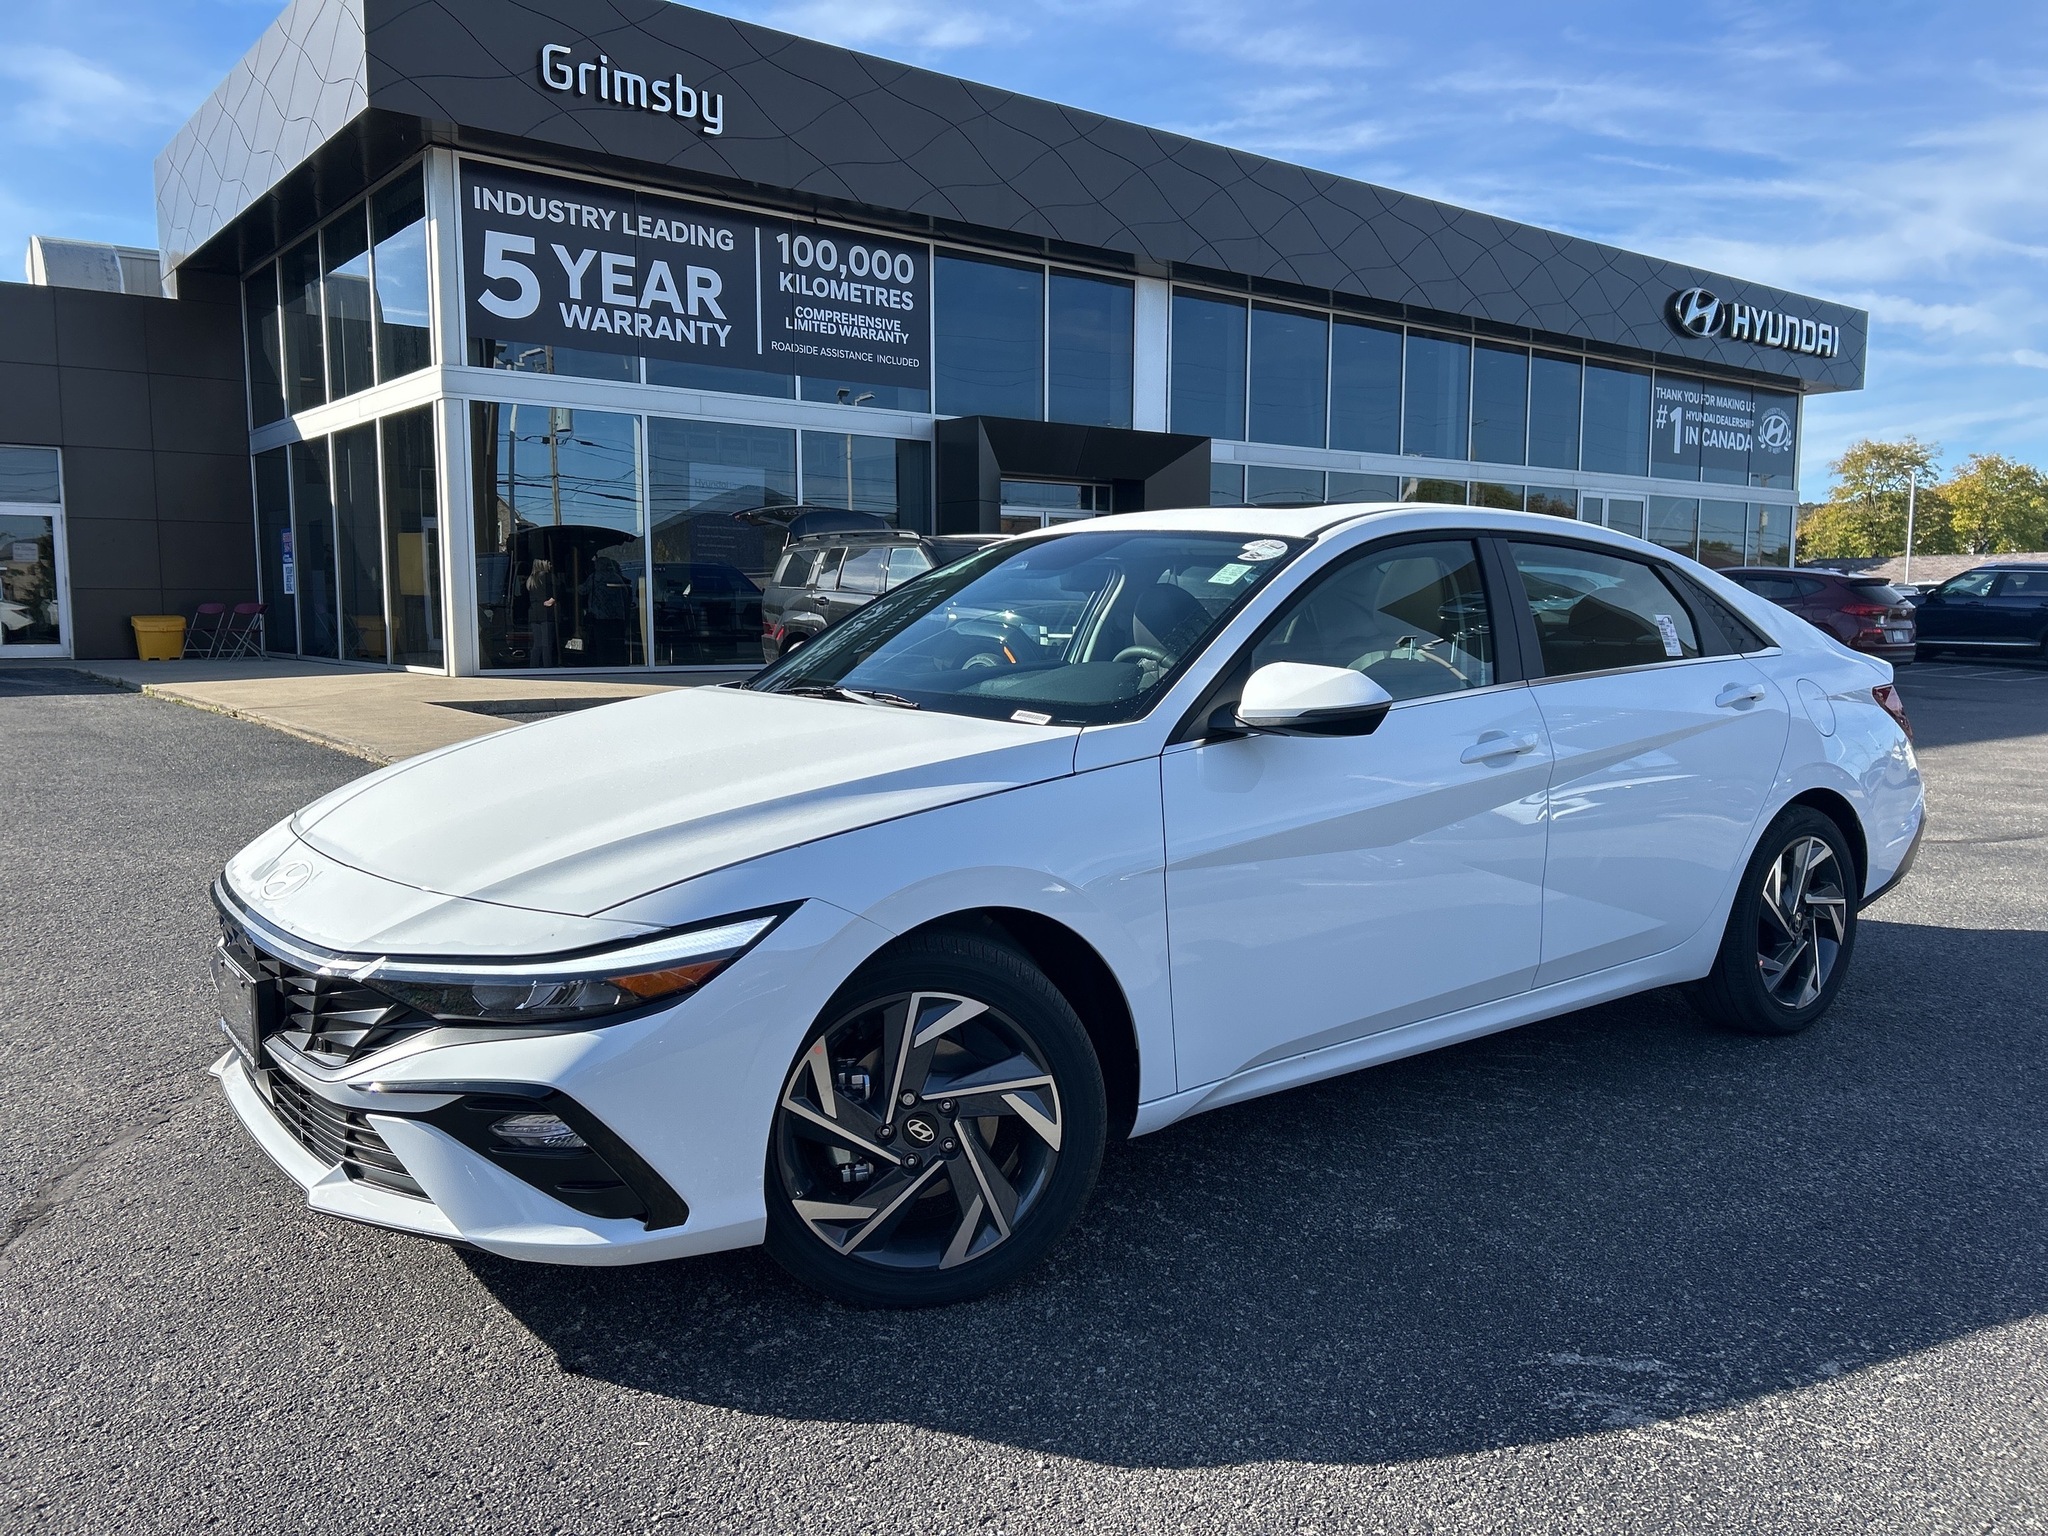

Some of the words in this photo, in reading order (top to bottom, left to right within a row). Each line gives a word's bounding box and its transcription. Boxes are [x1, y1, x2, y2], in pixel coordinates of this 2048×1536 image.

[542, 43, 723, 135] Grimsby
[473, 185, 617, 232] INDUSTRY
[622, 212, 734, 251] LEADING
[477, 229, 541, 319] 5
[550, 243, 728, 320] YEAR
[776, 232, 915, 285] 100,000
[779, 271, 914, 311] KILOMETRES
[558, 302, 732, 348] WARRANTY
[785, 316, 837, 335] LIMITED
[839, 324, 910, 345] WARRANTY
[795, 305, 902, 332] COMPREHENSIVE
[1731, 302, 1839, 358] HYUNDAI
[771, 340, 819, 356] ROADSIDE
[819, 347, 874, 363] ASSISTANCE
[876, 354, 920, 368] INCLUDED
[1655, 386, 1683, 402] THANK
[1683, 390, 1700, 405] YOU
[1700, 393, 1716, 407] FOR
[1716, 396, 1746, 412] MAKING
[1746, 401, 1756, 413] US
[1685, 410, 1716, 424] HYUNDAI
[1656, 404, 1682, 454] #1
[1685, 425, 1699, 446] IN
[1701, 427, 1754, 453] CANADA
